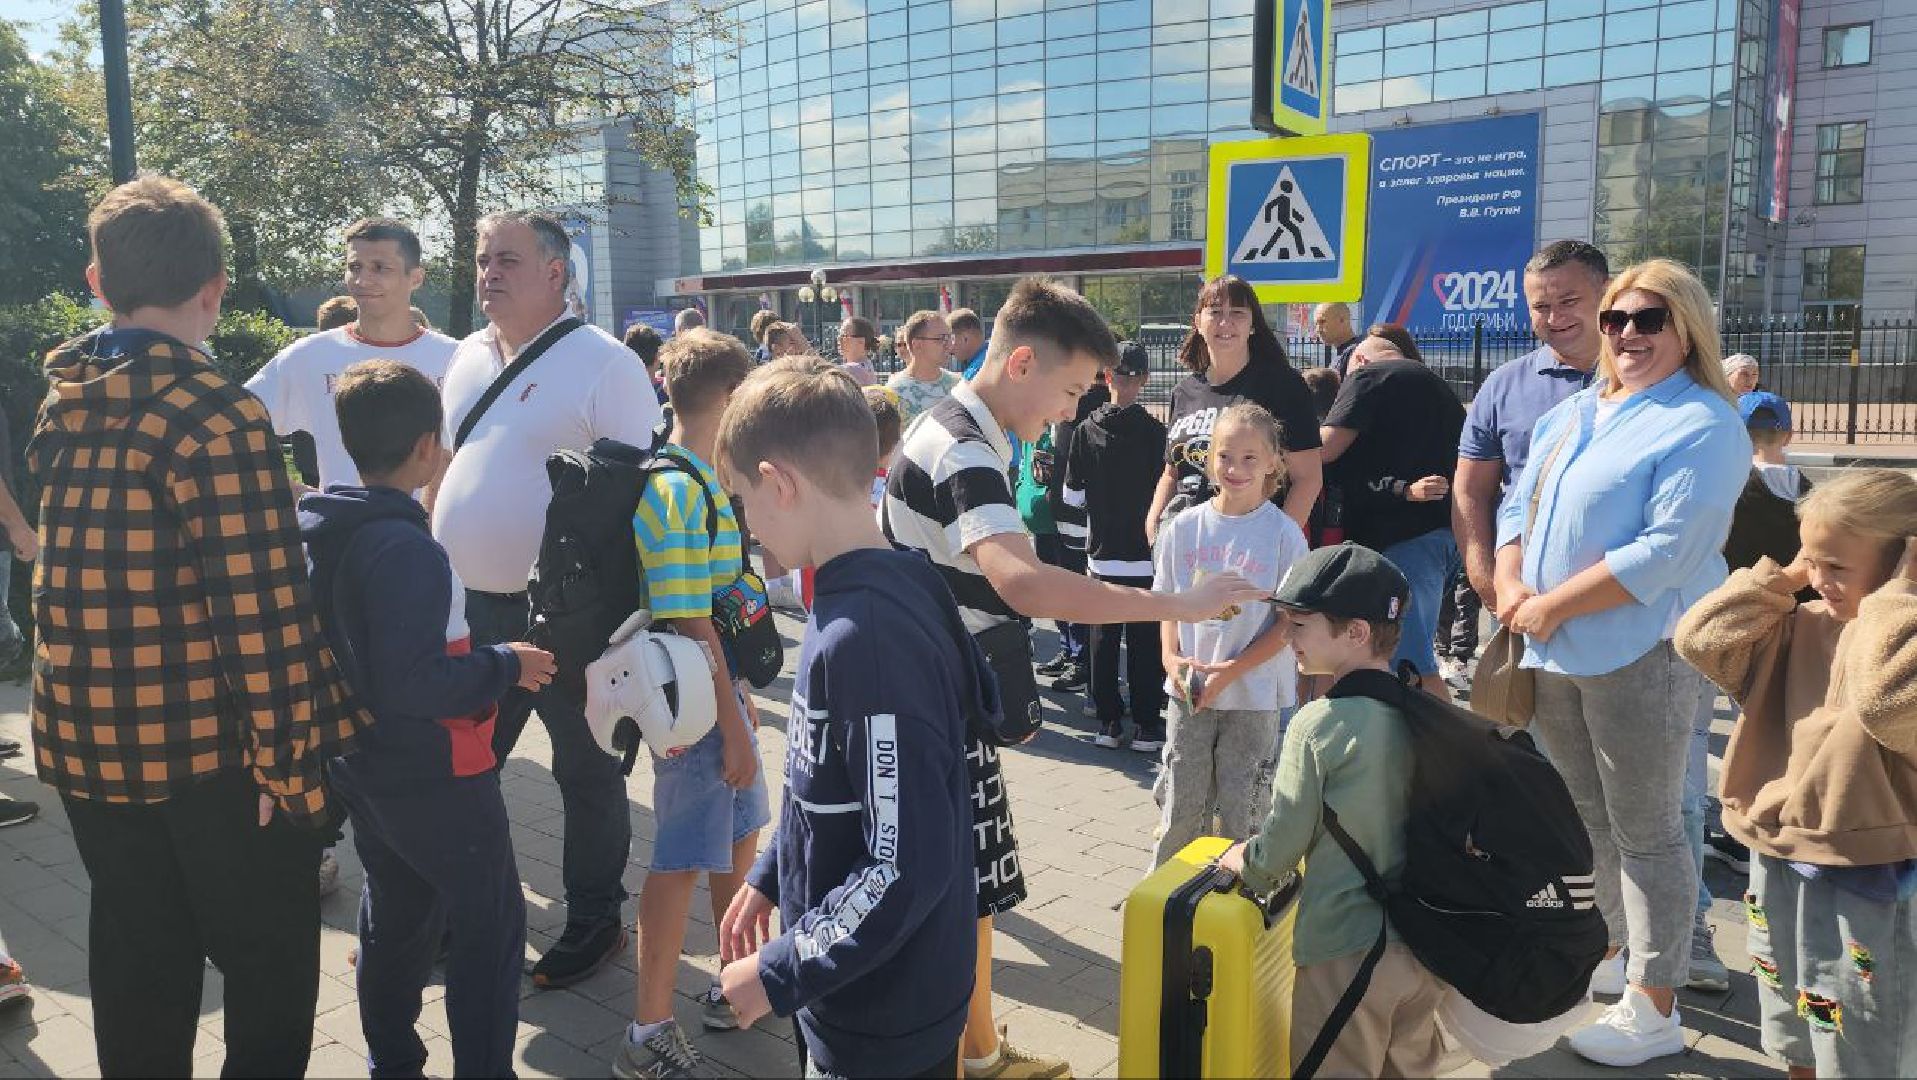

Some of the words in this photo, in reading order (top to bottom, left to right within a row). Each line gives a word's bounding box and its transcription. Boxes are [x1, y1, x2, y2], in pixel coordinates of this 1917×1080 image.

[1379, 152, 1442, 172] СПОРТ
[1454, 156, 1474, 165] это
[1477, 153, 1491, 163] не
[1378, 179, 1386, 188] а
[1391, 177, 1422, 188] залог
[1426, 170, 1480, 185] здоровья
[1436, 192, 1500, 207] Президент
[1502, 189, 1522, 200] РФ
[1483, 205, 1521, 218] Путин
[1444, 268, 1518, 311] 2024
[1526, 896, 1564, 909] adidas
